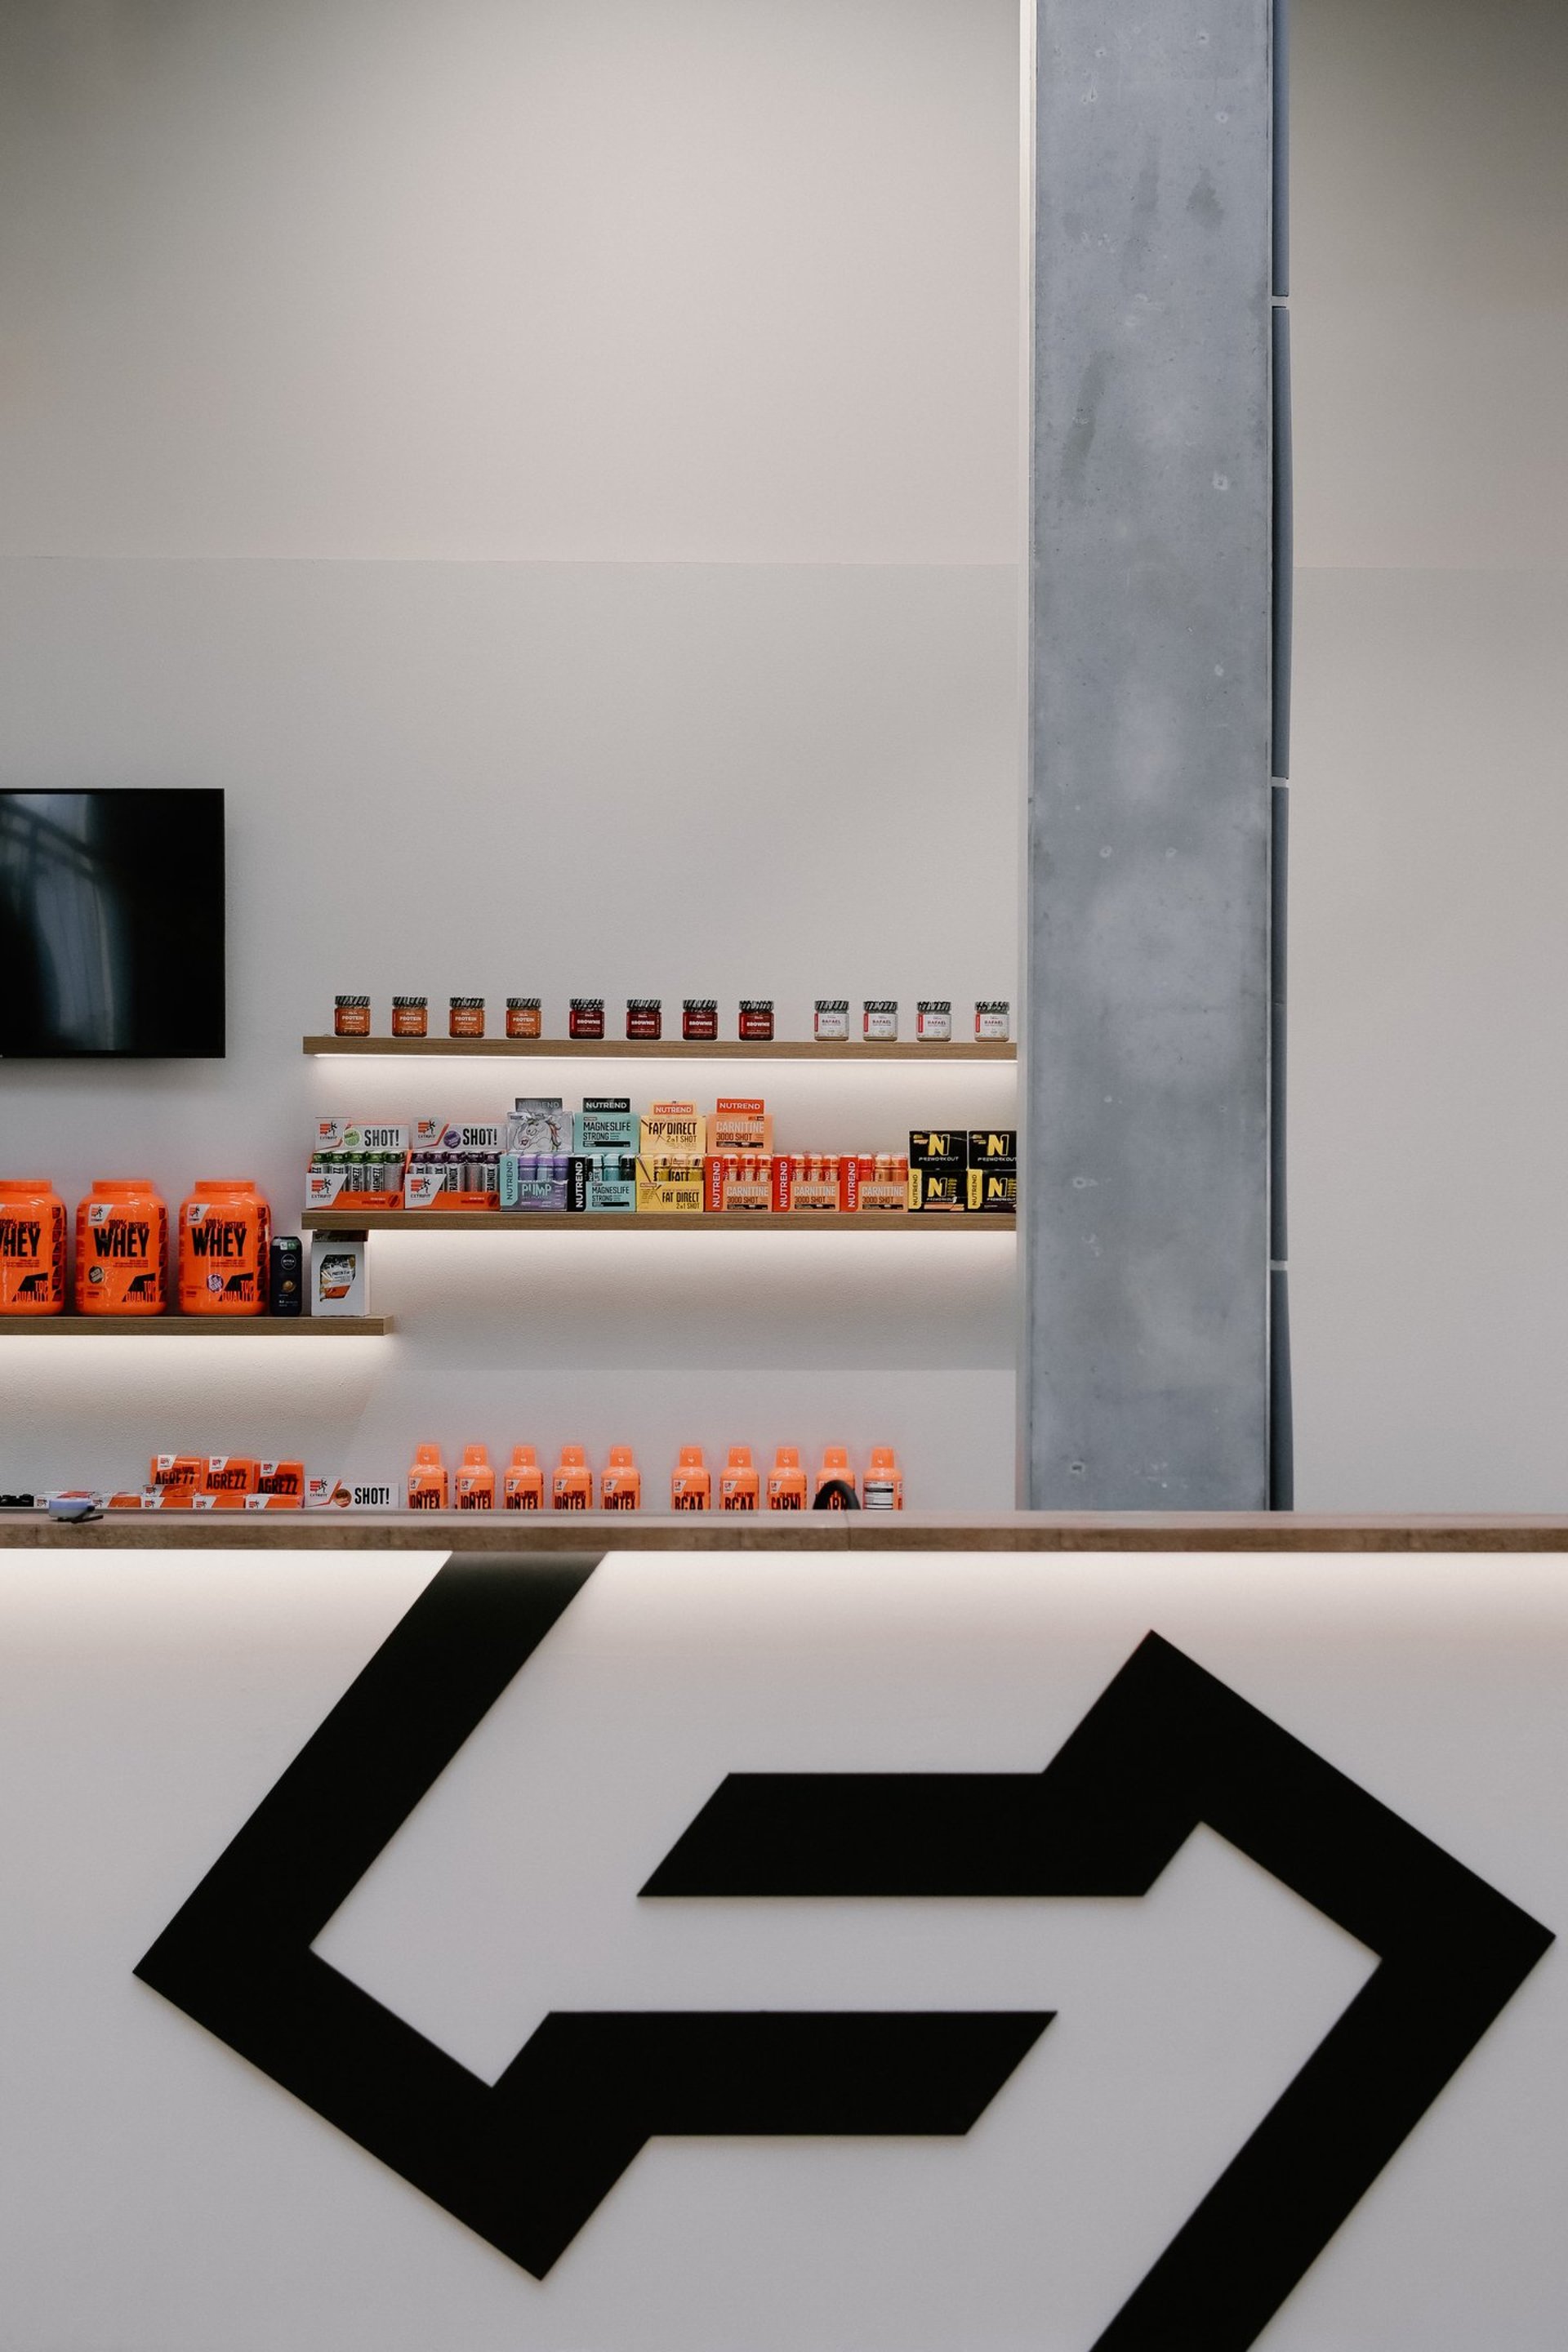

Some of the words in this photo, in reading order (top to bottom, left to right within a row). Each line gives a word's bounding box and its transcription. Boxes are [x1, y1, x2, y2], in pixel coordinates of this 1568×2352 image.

[719, 1102, 760, 1110] NUTREND
[583, 1122, 631, 1131] MAGNESLIFE
[648, 1123, 663, 1135] FAT
[666, 1123, 697, 1135] DIRECT
[716, 1121, 764, 1133] CARNITINE
[364, 1129, 399, 1147] SHOT!
[462, 1129, 497, 1146] SHOT!
[583, 1132, 609, 1141] STRONG
[680, 1135, 697, 1143] SHOT
[716, 1133, 733, 1141] 3000
[735, 1133, 752, 1141] SHOT
[522, 1183, 553, 1197] PUMP
[575, 1161, 583, 1208] NUTREND
[712, 1160, 720, 1207] NUTREND
[780, 1160, 788, 1207] NUTREND
[847, 1160, 855, 1207] NUTREND
[591, 1187, 630, 1195] MAGNESLIFE
[662, 1192, 674, 1203] FAT
[677, 1192, 700, 1203] DIRECT
[727, 1186, 769, 1196] CARNITINE
[794, 1186, 836, 1196] CARNITINE
[862, 1186, 904, 1196] CARNITINE
[590, 1195, 612, 1203] STRONG
[93, 1227, 150, 1258] WHEY
[191, 1227, 247, 1257] WHEY
[35, 1281, 49, 1290] TOP
[144, 1281, 157, 1290] TOP
[241, 1281, 254, 1290] TOP
[206, 1472, 247, 1490] AGREZZ
[256, 1477, 299, 1494] AGREZZ
[354, 1487, 390, 1504] SHOT!
[408, 1494, 441, 1509] IONTEX
[459, 1494, 492, 1509] IONTEX
[506, 1495, 539, 1509] IONTEX
[555, 1495, 587, 1509] IONTEX
[604, 1495, 636, 1509] IONTEX
